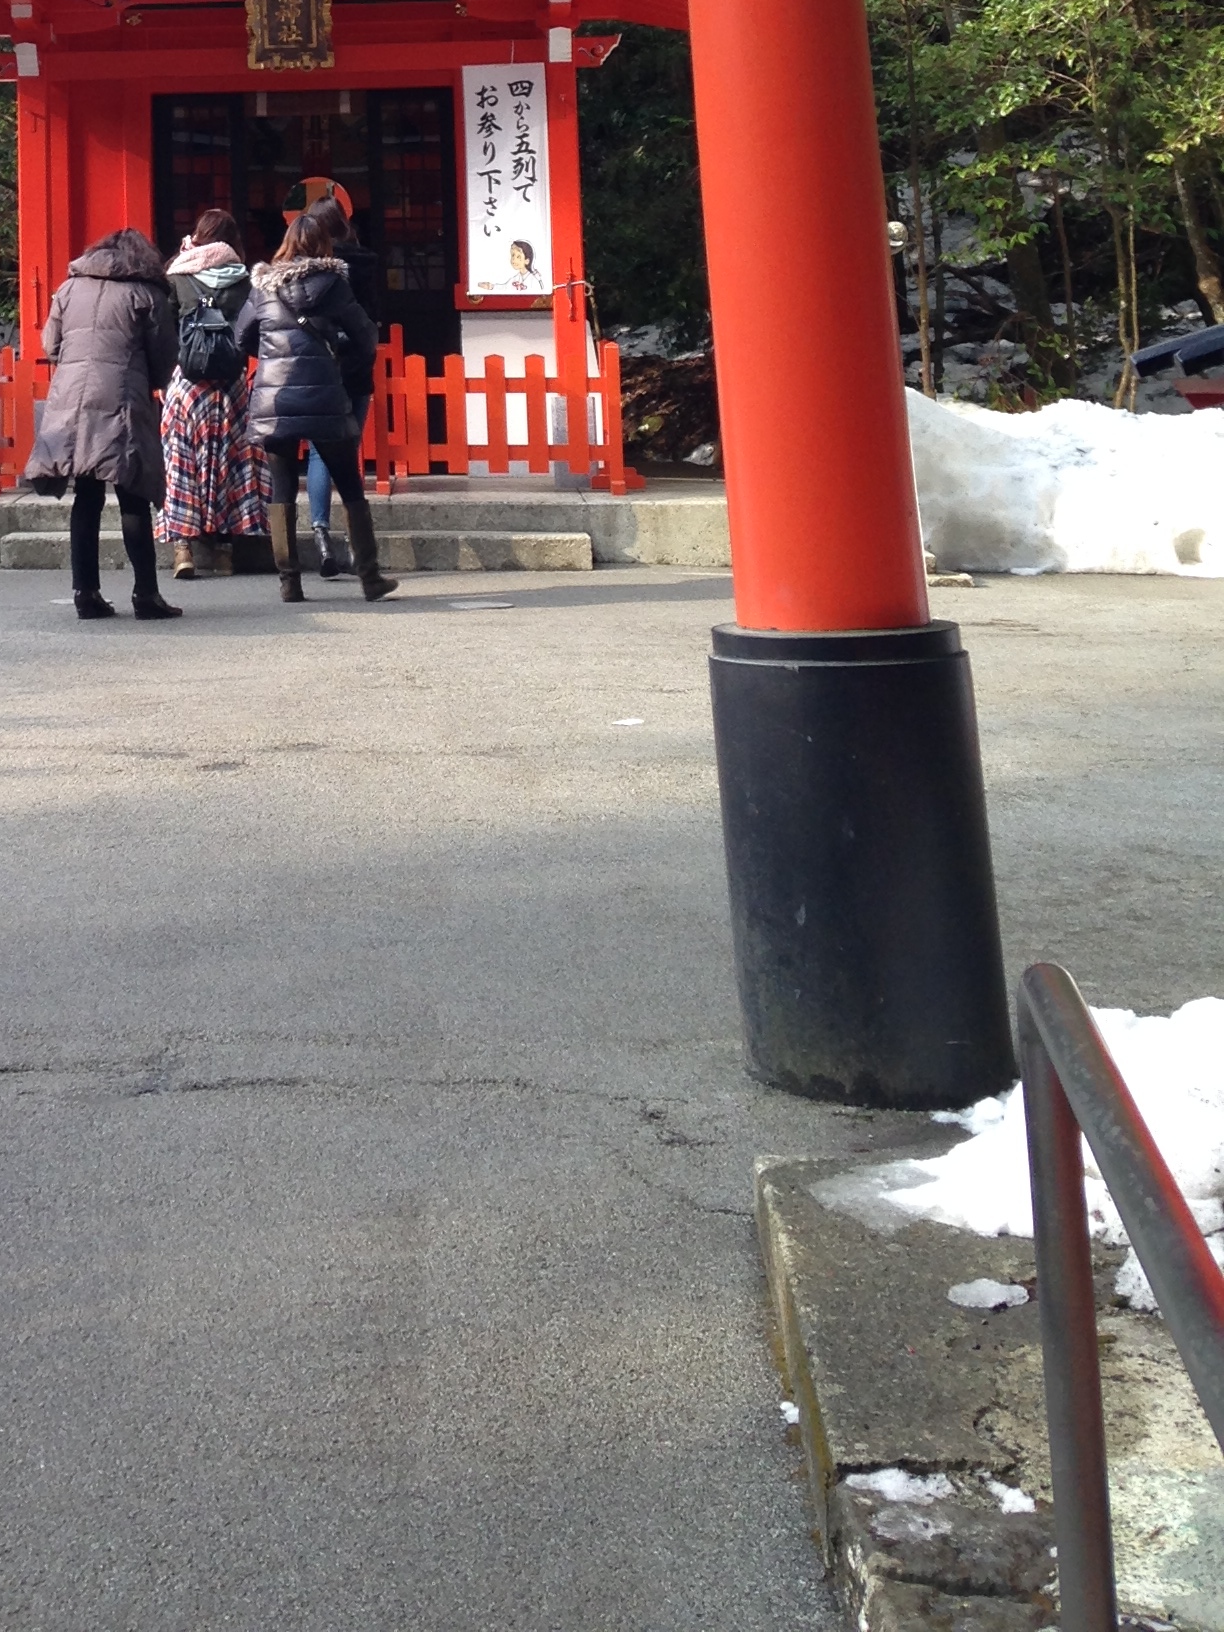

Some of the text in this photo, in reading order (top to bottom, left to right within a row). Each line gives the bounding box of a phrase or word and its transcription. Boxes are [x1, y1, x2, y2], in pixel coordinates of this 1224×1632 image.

[474, 84, 503, 237] お参り下さい
